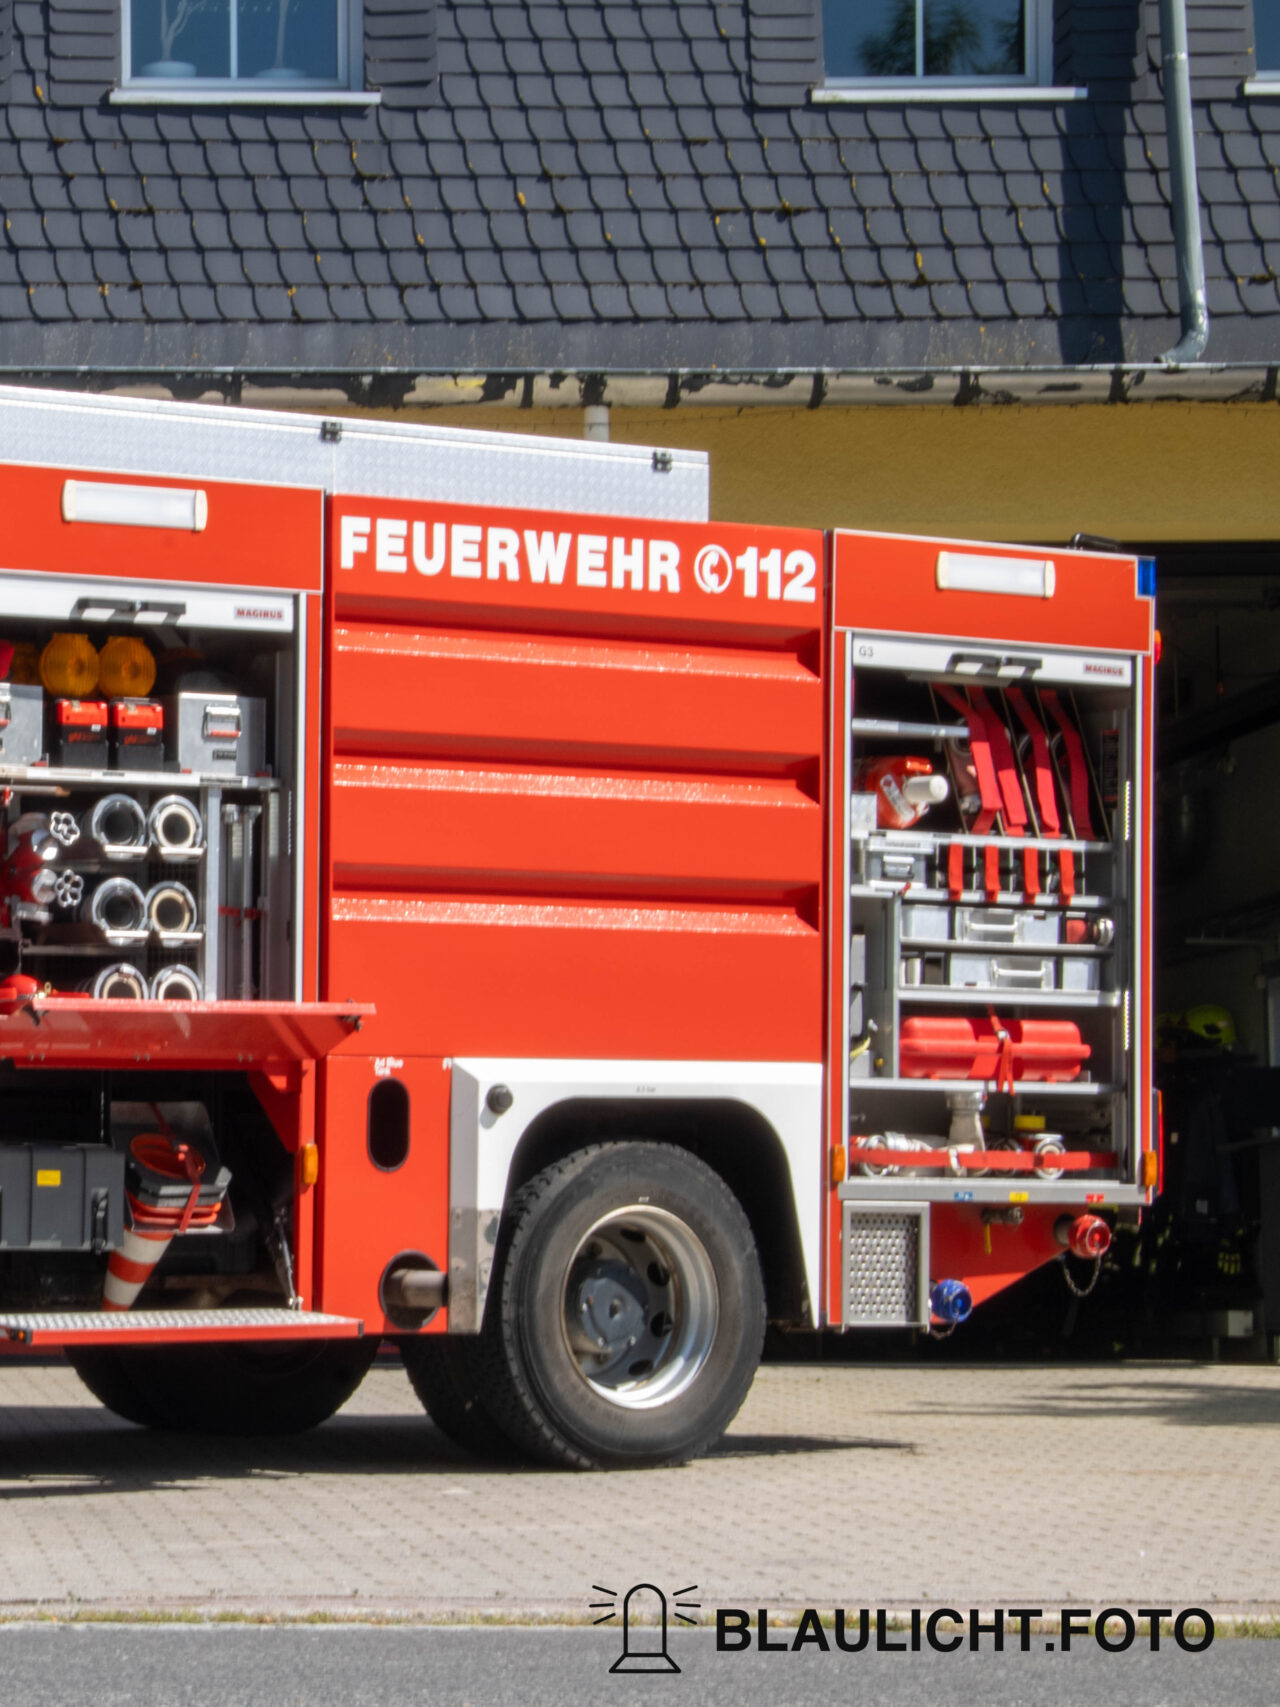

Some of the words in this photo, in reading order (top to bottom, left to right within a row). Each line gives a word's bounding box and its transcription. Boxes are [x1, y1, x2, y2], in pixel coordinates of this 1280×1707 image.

[340, 515, 680, 593] FEUERWEHR
[735, 546, 817, 603] 112
[236, 607, 283, 620] MAGIRUS
[859, 644, 874, 657] G3
[1085, 662, 1124, 676] MAGIRUS
